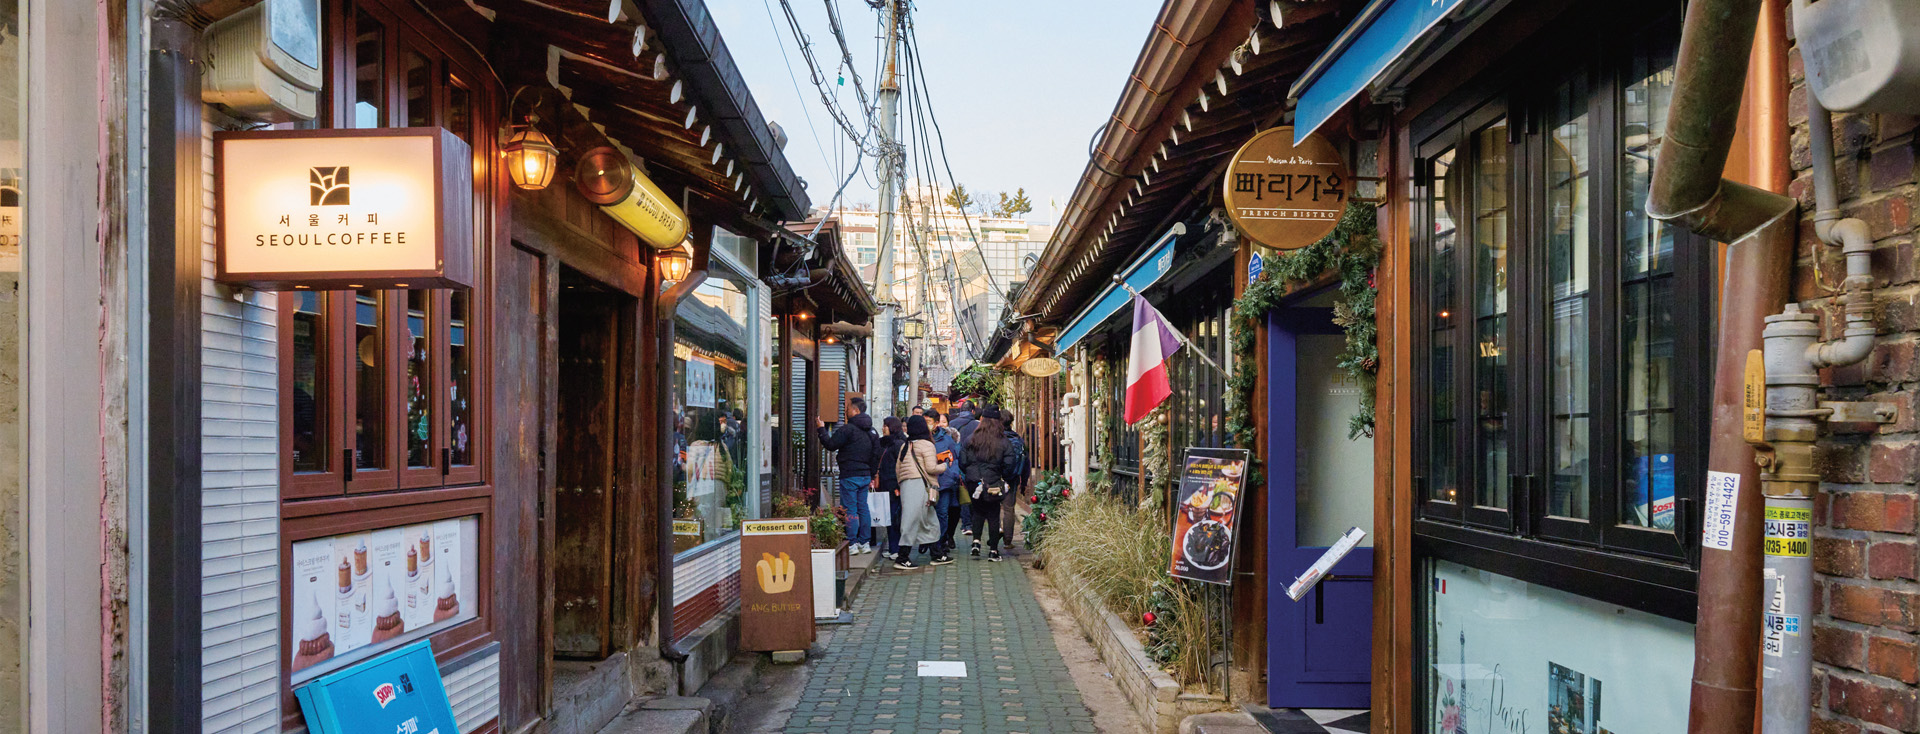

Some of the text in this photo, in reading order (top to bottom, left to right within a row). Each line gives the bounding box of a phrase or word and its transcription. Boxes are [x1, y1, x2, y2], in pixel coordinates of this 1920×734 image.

[1266, 155, 1313, 165] Maison de Paris
[1234, 171, 1345, 202] 빠리가옥
[256, 232, 406, 247] SEOULCOFFEE
[1652, 501, 1675, 514] COST
[1717, 476, 1736, 547] 010-5911-4422
[746, 523, 804, 532] K-dessert cafe
[751, 603, 801, 613] ANG BUTTER
[1765, 615, 1784, 632] 시공
